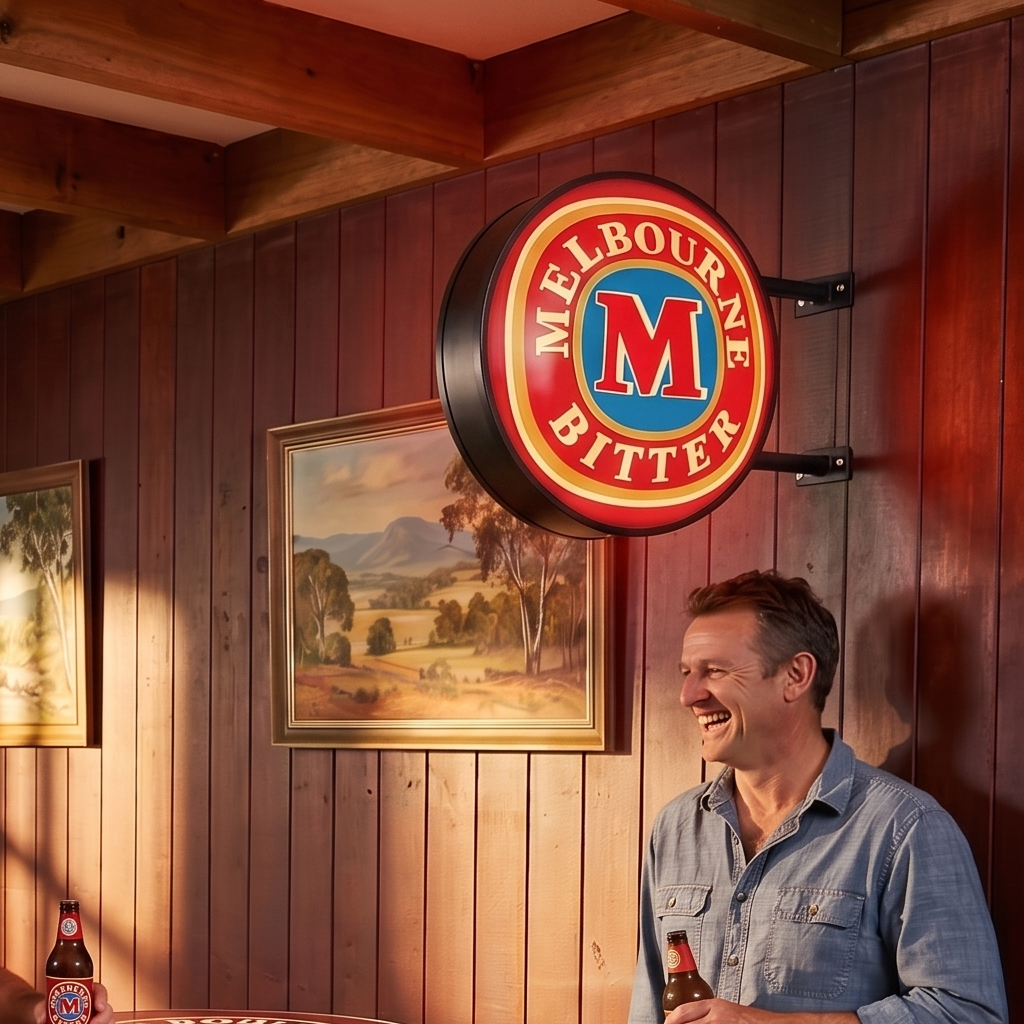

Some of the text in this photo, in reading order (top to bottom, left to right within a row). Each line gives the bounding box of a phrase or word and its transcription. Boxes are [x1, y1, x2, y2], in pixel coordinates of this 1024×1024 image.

[536, 221, 750, 369] MELBOURNE
[594, 290, 709, 400] M
[549, 402, 743, 484] BITTER
[59, 997, 81, 1015] M
